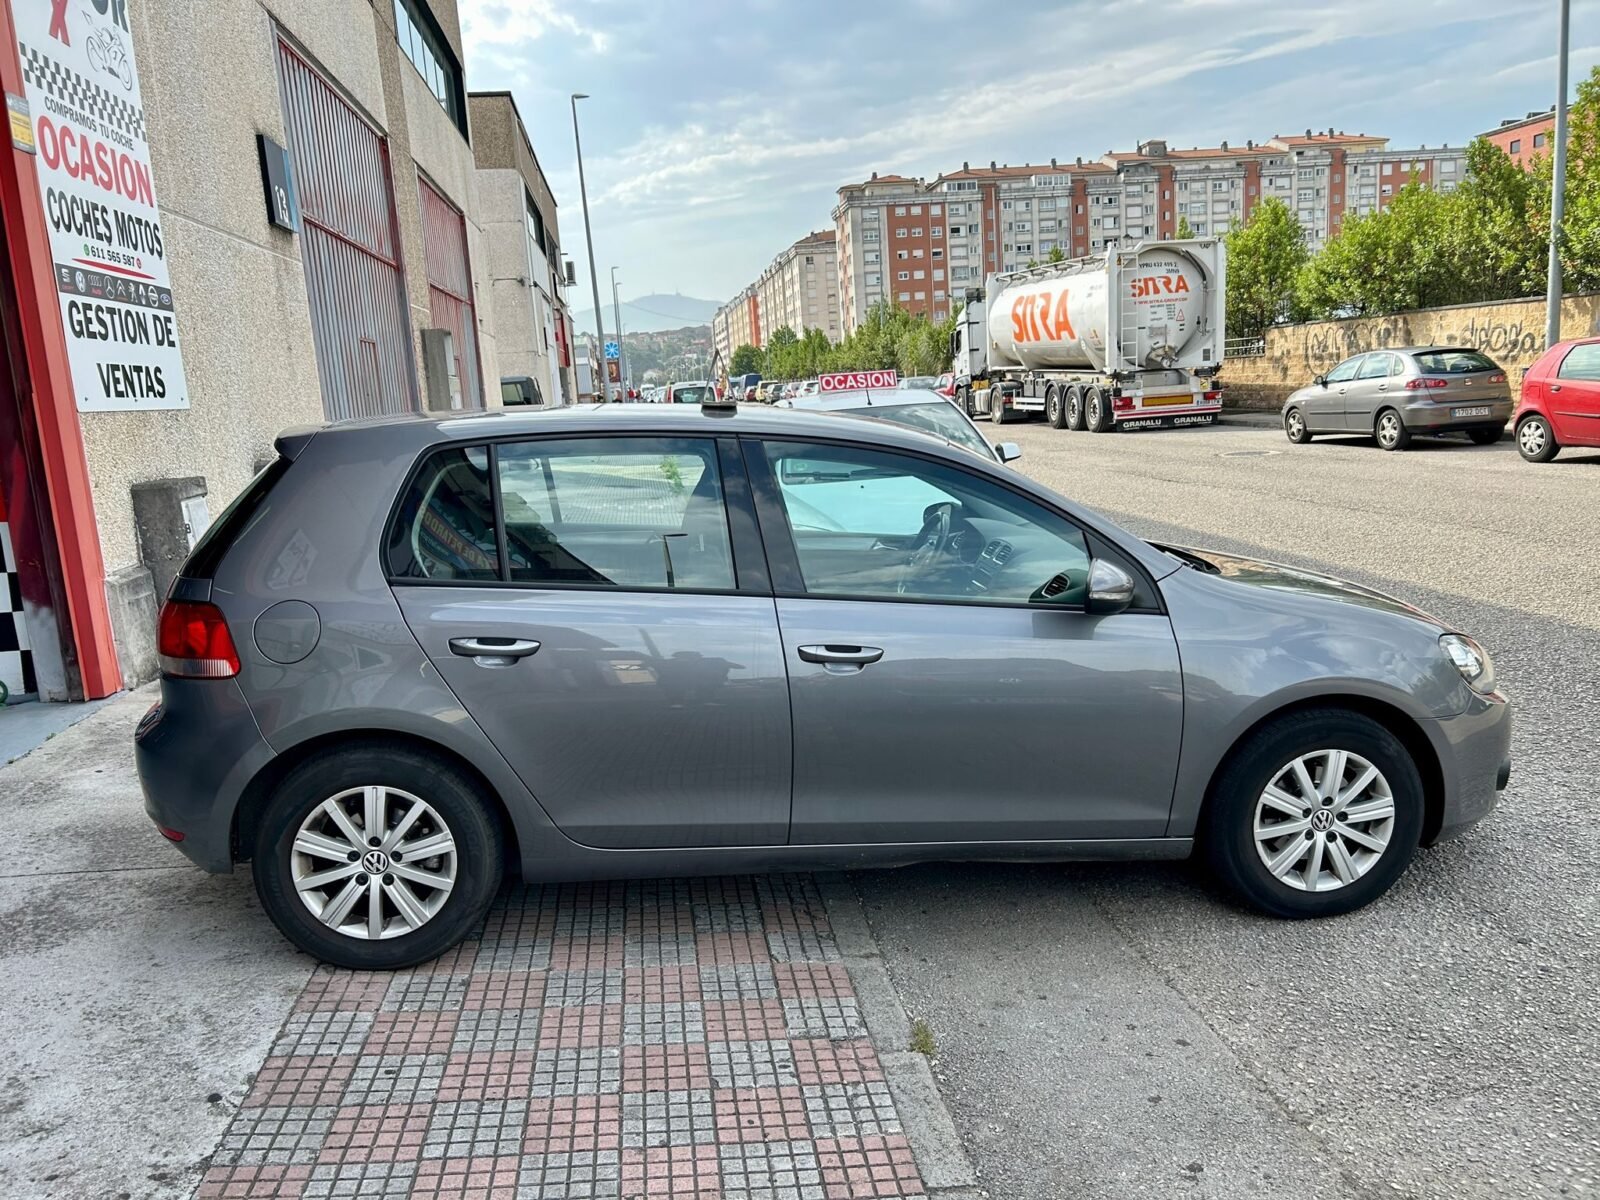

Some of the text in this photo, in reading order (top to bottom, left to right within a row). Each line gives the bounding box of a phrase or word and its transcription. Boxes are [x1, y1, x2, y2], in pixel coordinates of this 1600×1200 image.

[44, 96, 97, 132] COMPRAMOS
[99, 123, 110, 140] TU
[110, 129, 135, 151] COCHE
[37, 115, 154, 208] OCASION
[46, 186, 164, 261] COCHES MOTOS
[274, 184, 289, 224] 13
[90, 245, 136, 267] 611 565 587
[68, 300, 176, 347] GESTION DE
[96, 363, 166, 399] VENTAS
[822, 372, 895, 390] OCASION
[1123, 418, 1162, 428] GRANALU
[1173, 415, 1213, 424] GRANALU
